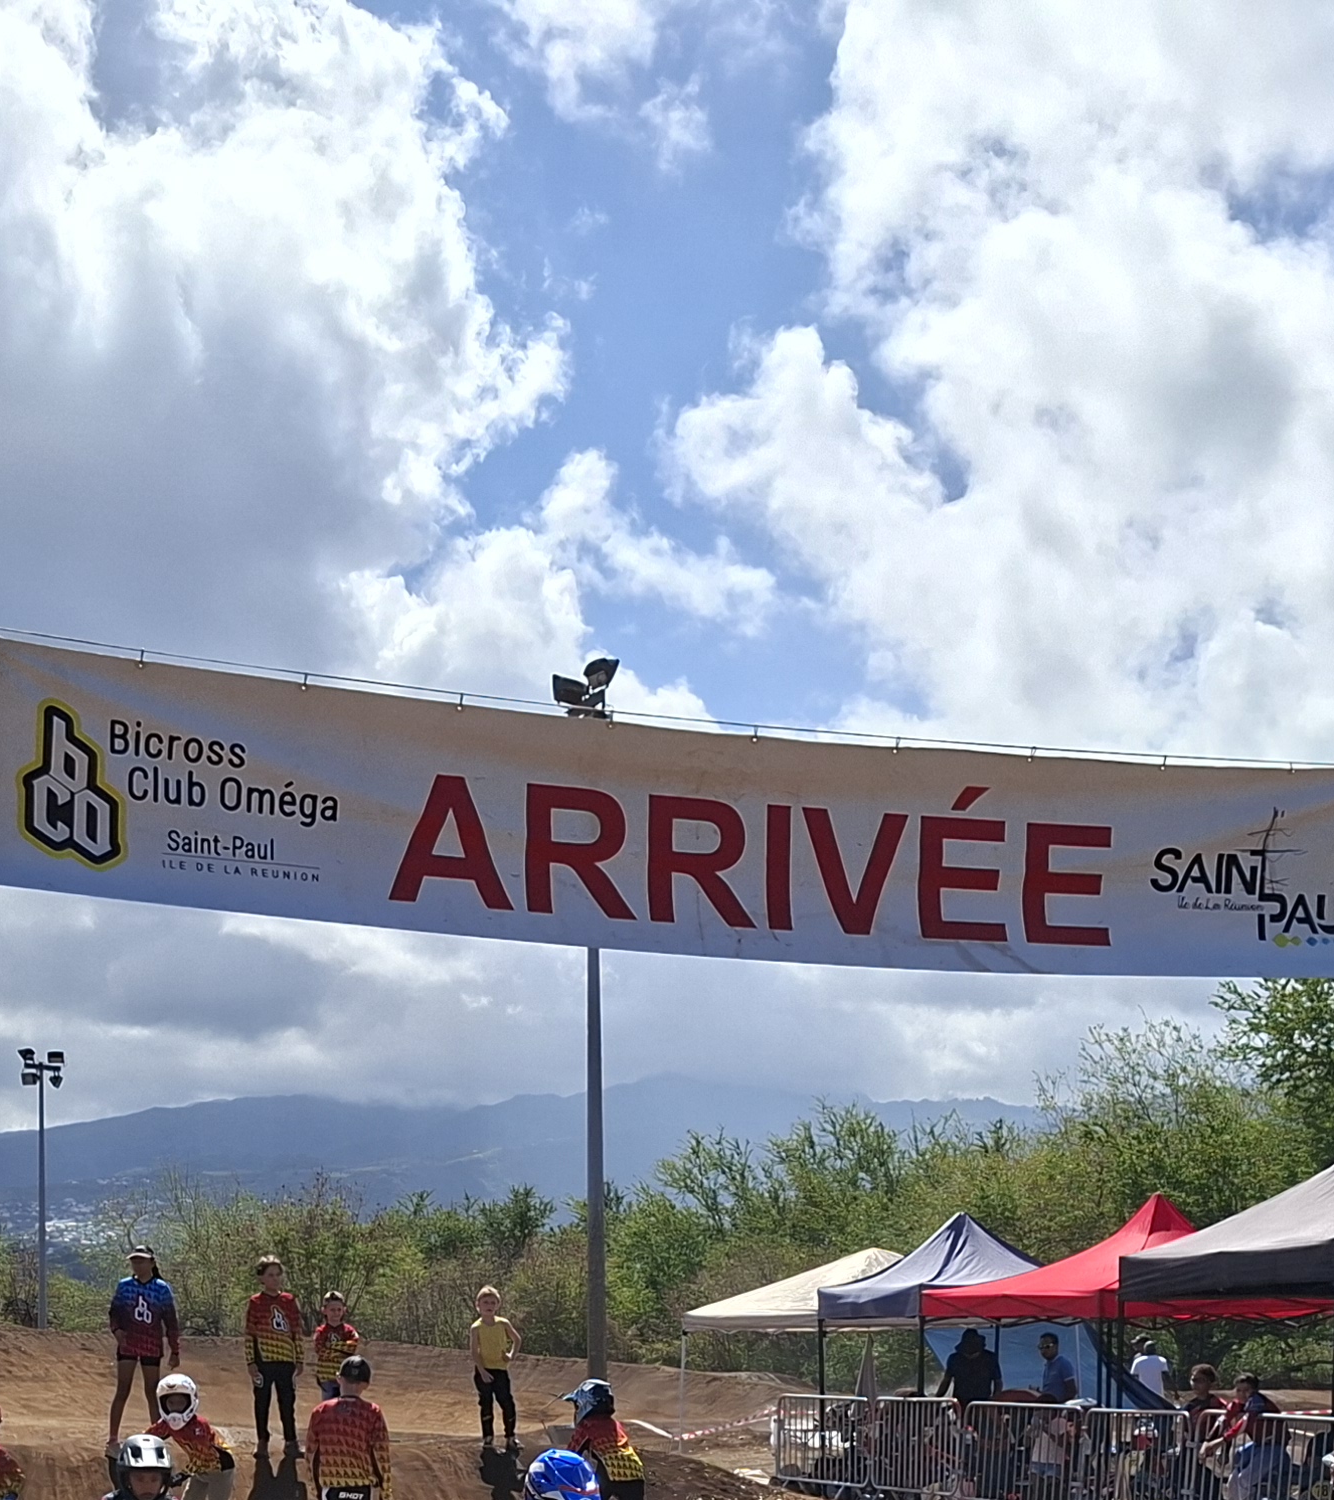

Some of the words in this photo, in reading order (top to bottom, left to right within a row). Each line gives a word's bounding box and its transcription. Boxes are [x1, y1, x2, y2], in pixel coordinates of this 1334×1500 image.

[109, 719, 246, 769] Bicross
[128, 765, 206, 807] Club
[219, 780, 339, 828] Oméga
[167, 829, 275, 861] Saint-Paul
[388, 773, 1113, 946] ARRIVÉE
[162, 859, 187, 870] ILE
[196, 862, 216, 873] DE
[224, 865, 241, 876] LA
[250, 867, 320, 883] REUNION
